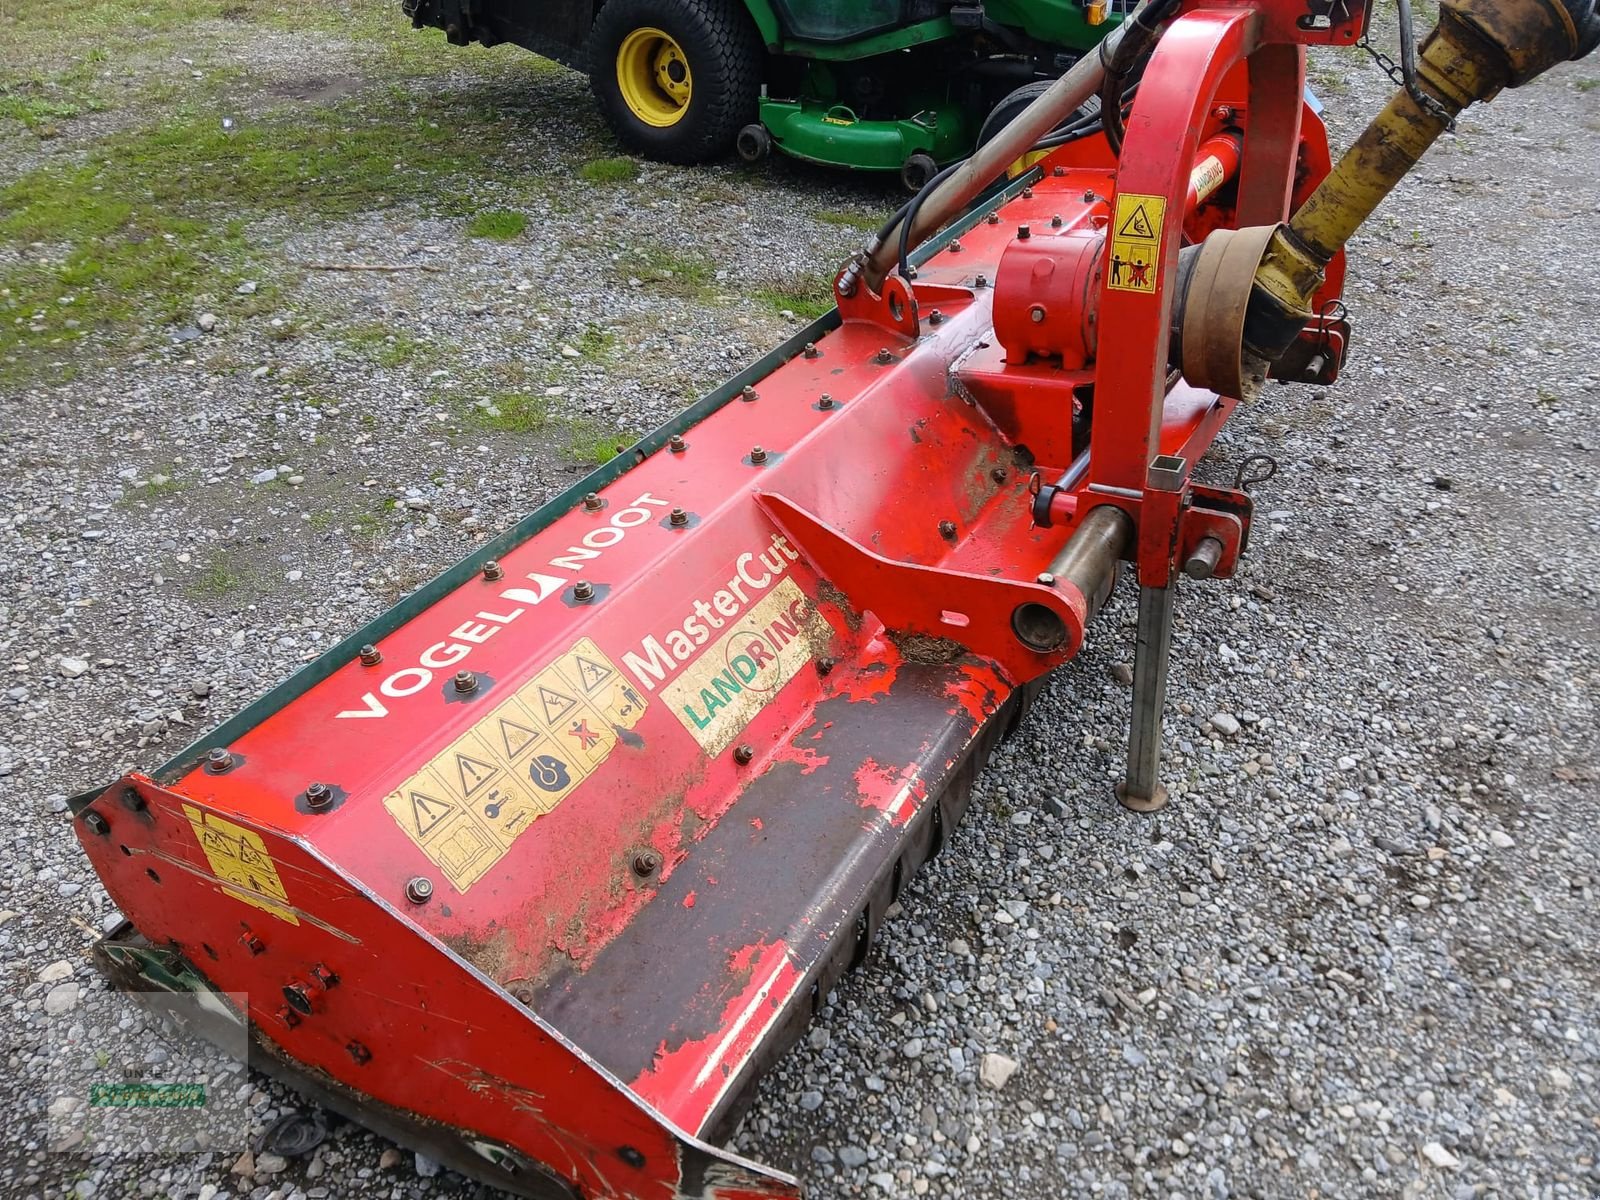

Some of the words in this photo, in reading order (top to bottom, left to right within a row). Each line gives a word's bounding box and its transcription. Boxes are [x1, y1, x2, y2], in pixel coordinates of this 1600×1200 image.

[336, 608, 525, 719] VOGEL
[548, 492, 671, 571] NOOT
[620, 533, 799, 691] MasterCut
[683, 599, 811, 730] LANDRING
